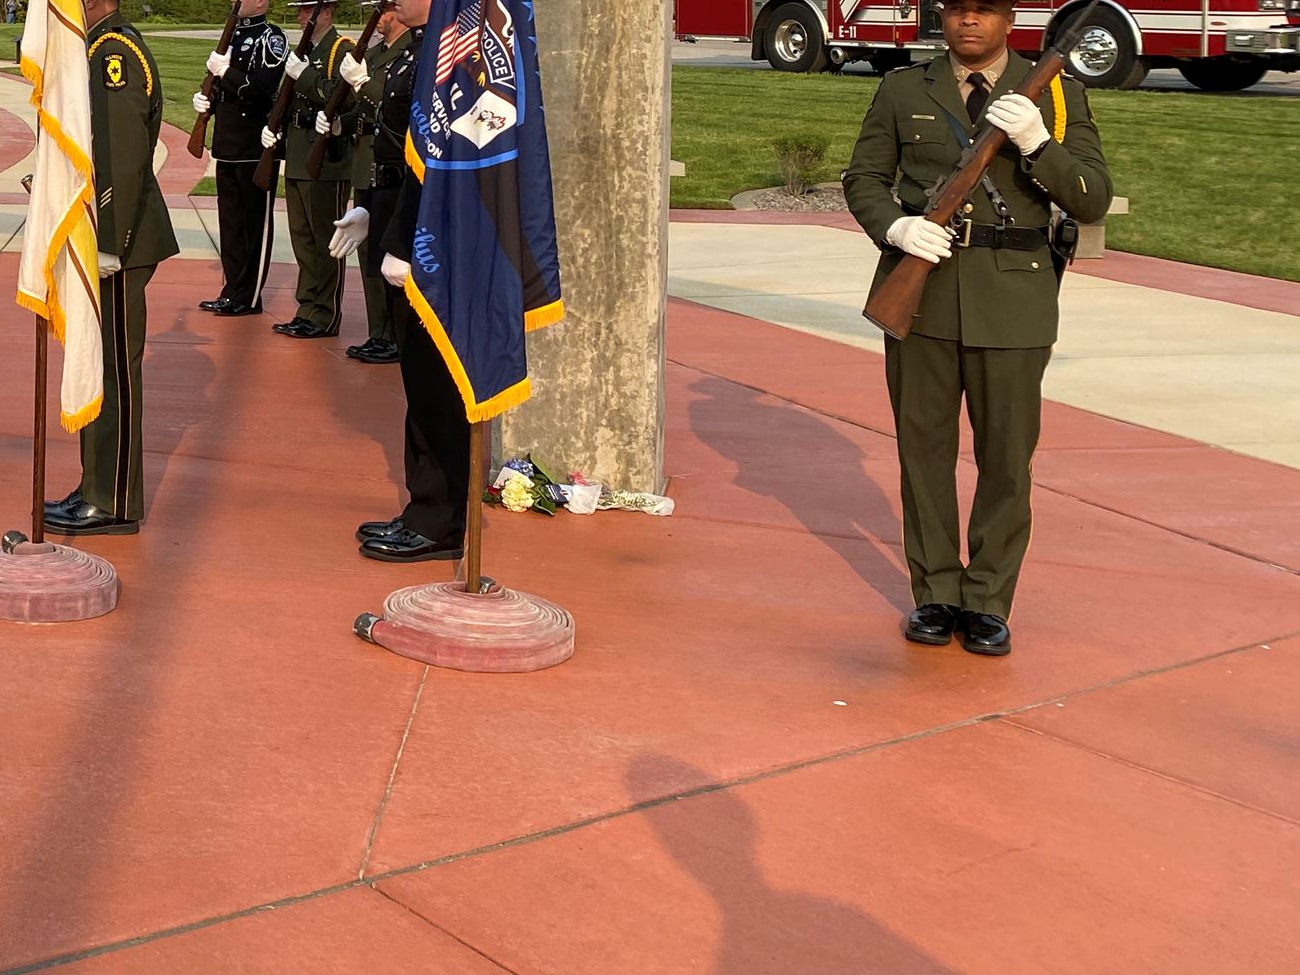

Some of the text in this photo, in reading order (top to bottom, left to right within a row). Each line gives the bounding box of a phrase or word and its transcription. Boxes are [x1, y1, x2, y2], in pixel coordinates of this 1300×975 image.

[838, 25, 857, 39] E-11
[482, 30, 508, 76] POLICE
[432, 90, 452, 141] ERVICE
[427, 142, 443, 159] ON
